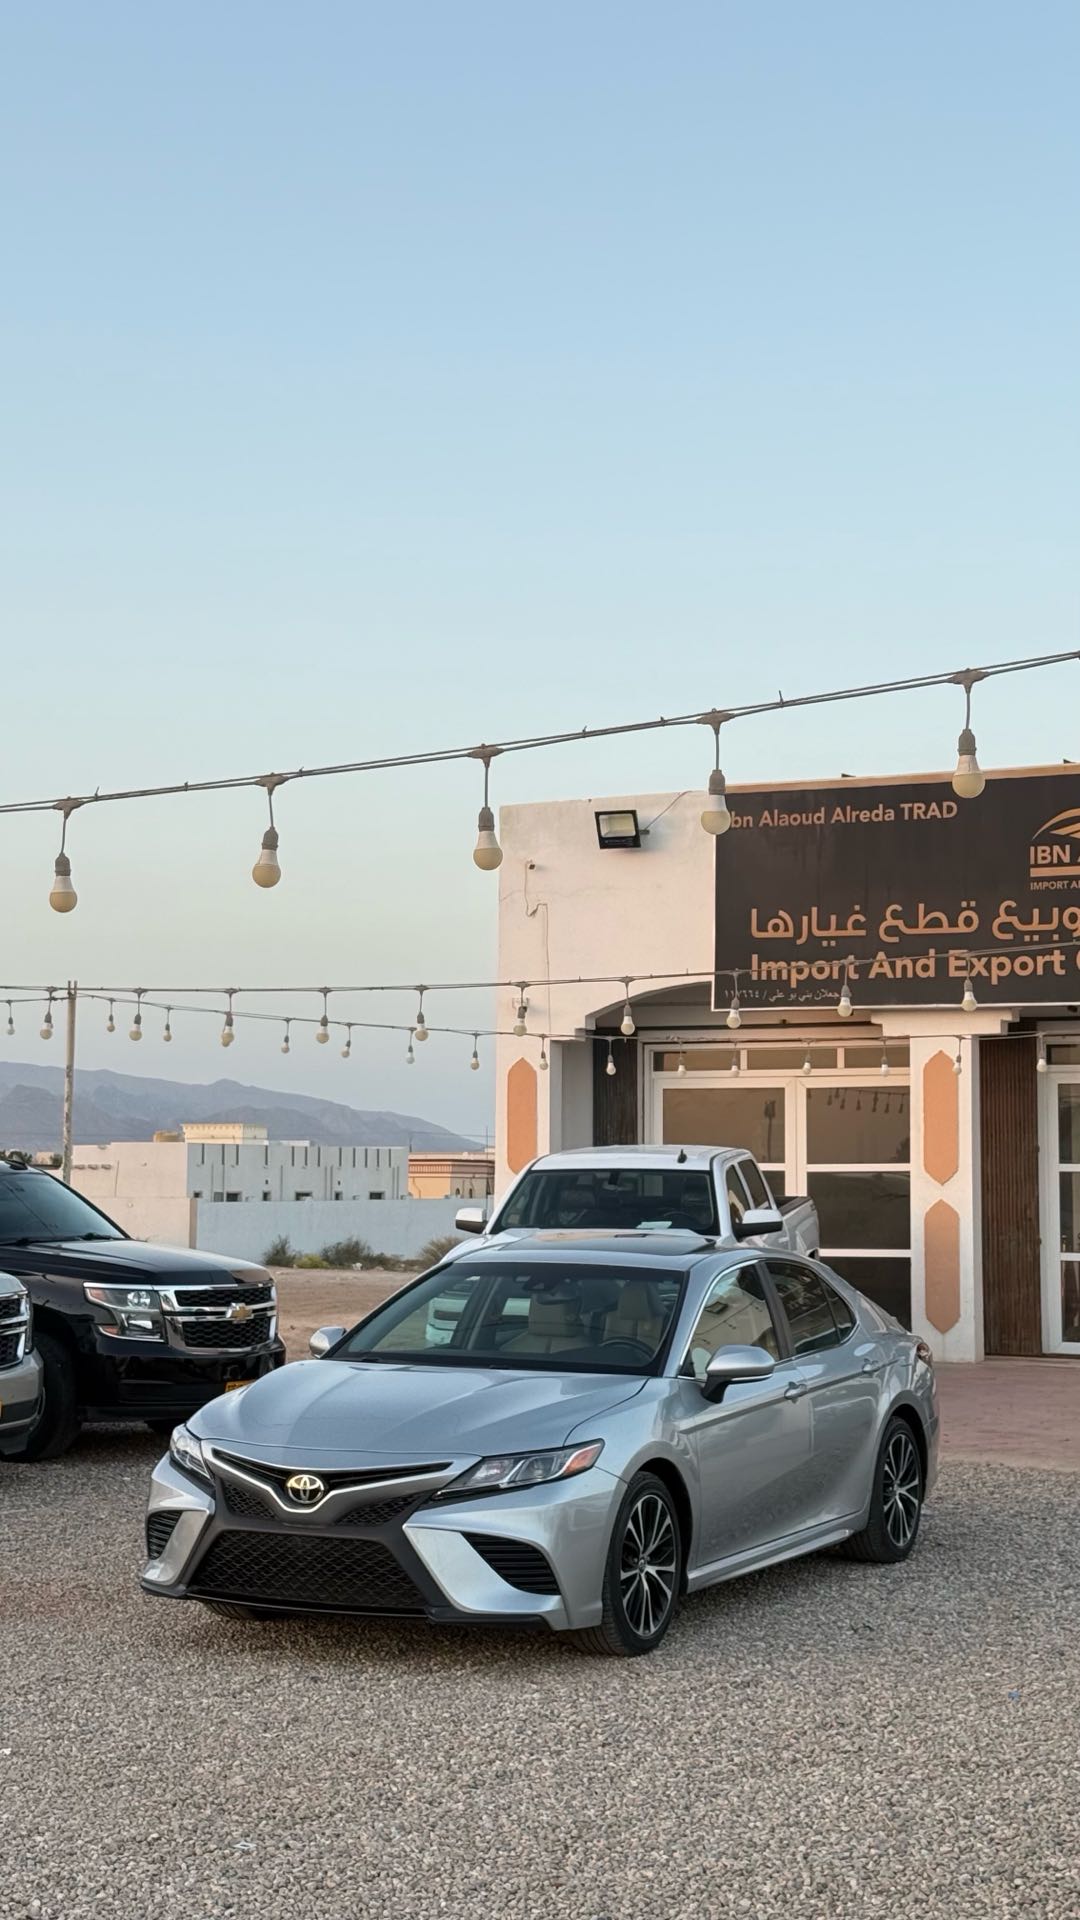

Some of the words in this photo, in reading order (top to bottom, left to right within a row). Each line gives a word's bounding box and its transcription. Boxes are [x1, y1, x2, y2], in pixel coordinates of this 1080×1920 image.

[730, 810, 753, 829] bn
[758, 807, 825, 828] Alaoud
[831, 803, 895, 824] Alreda
[900, 801, 958, 821] TRAD
[1030, 844, 1070, 865] IBN
[1030, 880, 1069, 891] IMPORT
[751, 904, 866, 947] غيارها
[879, 900, 979, 943] قطع
[751, 953, 860, 988] Import
[868, 949, 936, 980] And
[948, 949, 1066, 985] Export
